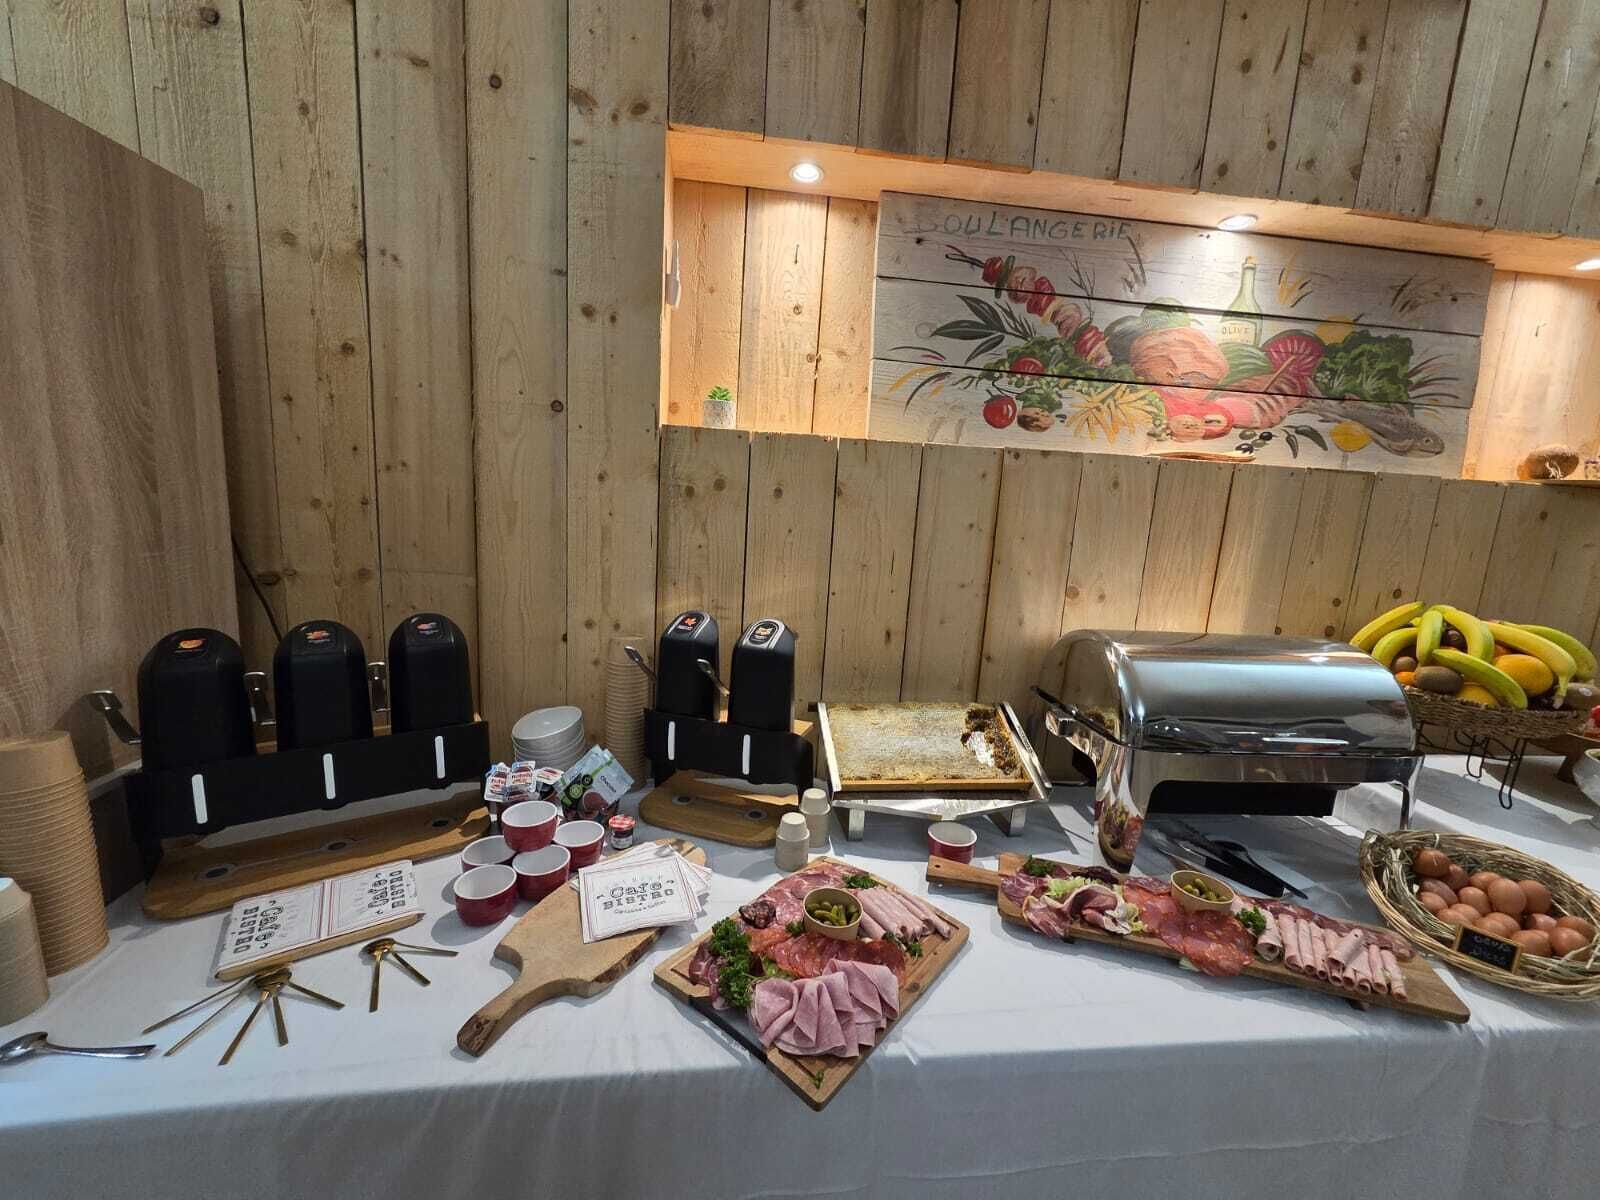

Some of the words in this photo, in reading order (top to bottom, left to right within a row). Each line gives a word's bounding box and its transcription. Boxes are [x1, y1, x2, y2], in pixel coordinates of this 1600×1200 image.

[389, 870, 406, 909] BISTRO
[603, 889, 674, 910] BISTRO
[233, 906, 260, 954] BISTRO
